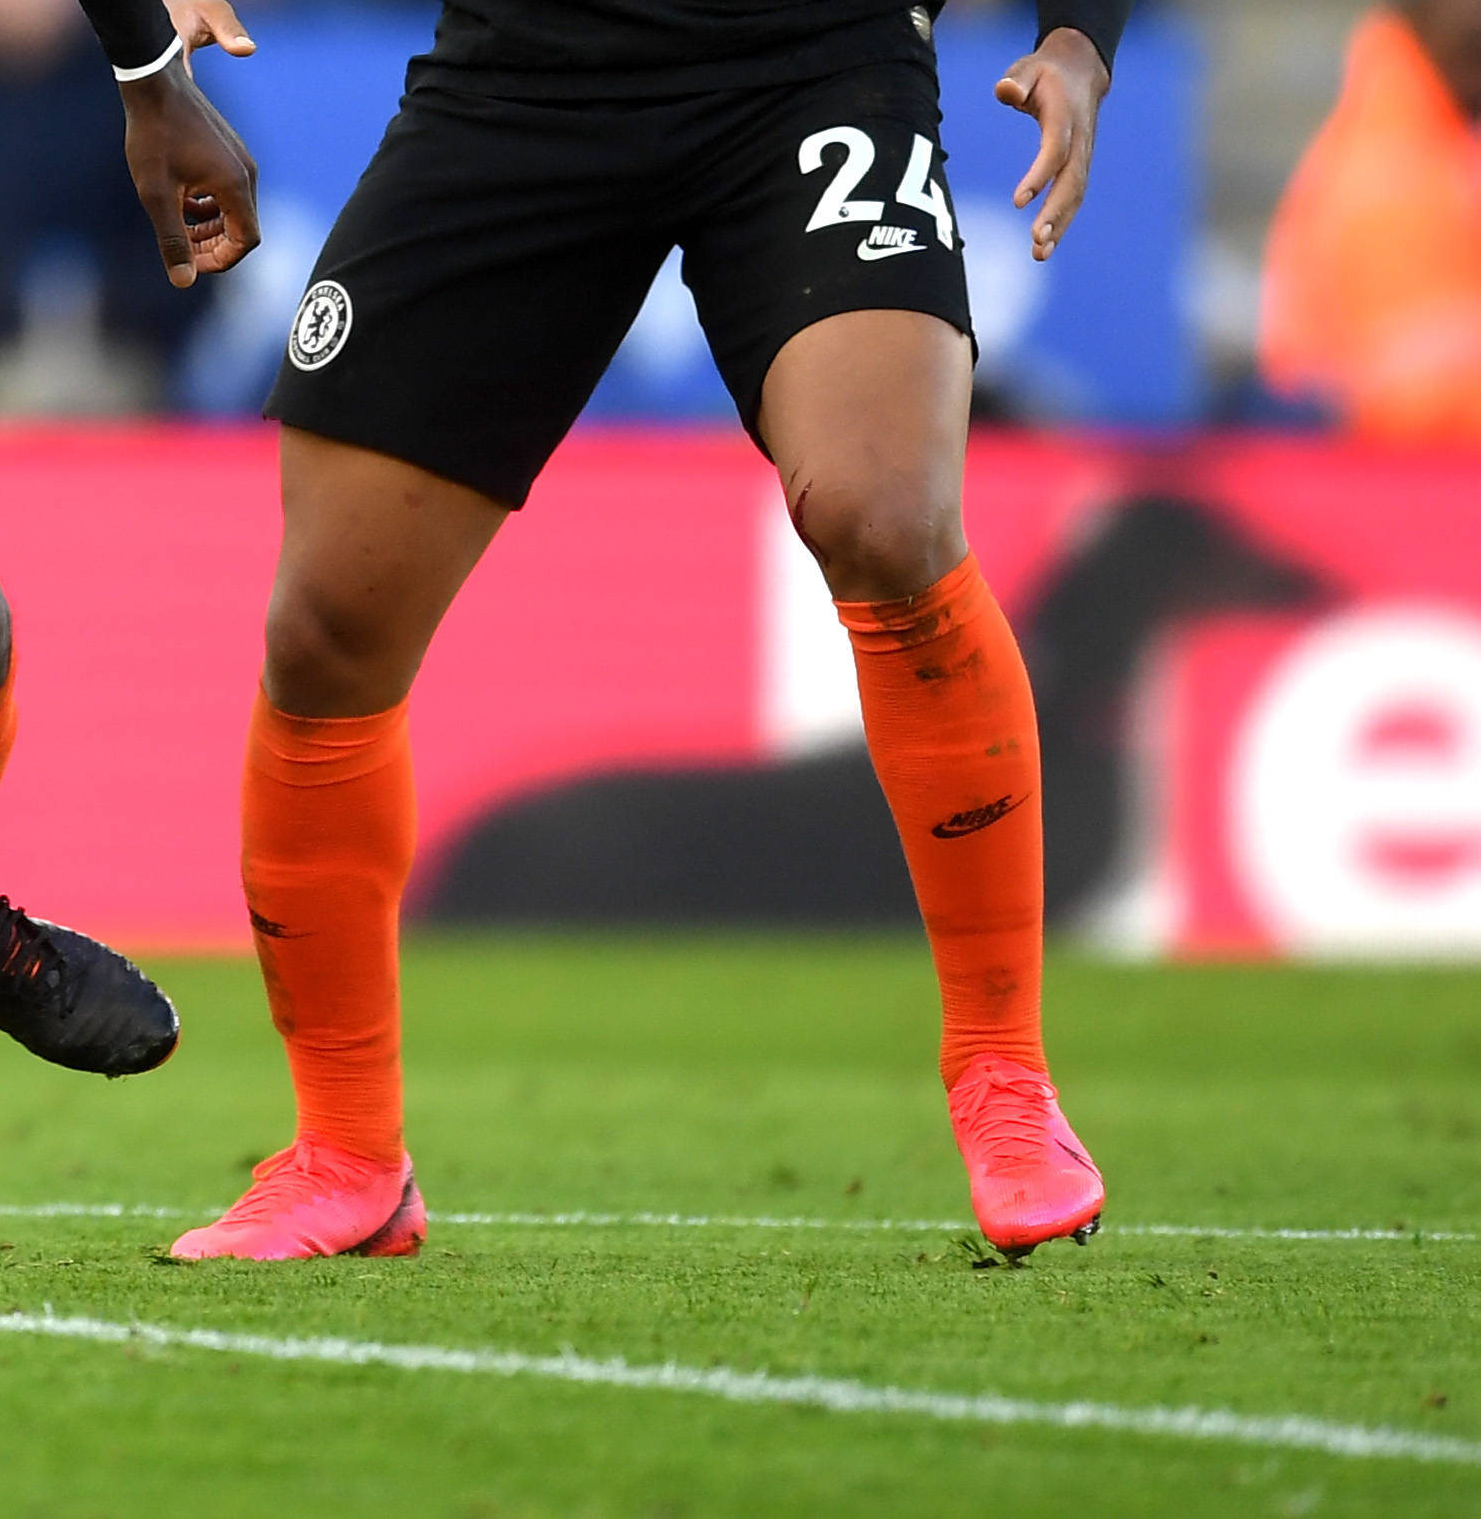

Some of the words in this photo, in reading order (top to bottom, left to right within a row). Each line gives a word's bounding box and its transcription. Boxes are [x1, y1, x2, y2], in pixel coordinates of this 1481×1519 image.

[798, 126, 954, 251] 24
[867, 225, 918, 248] NIKE
[947, 794, 1012, 828] NIKE
